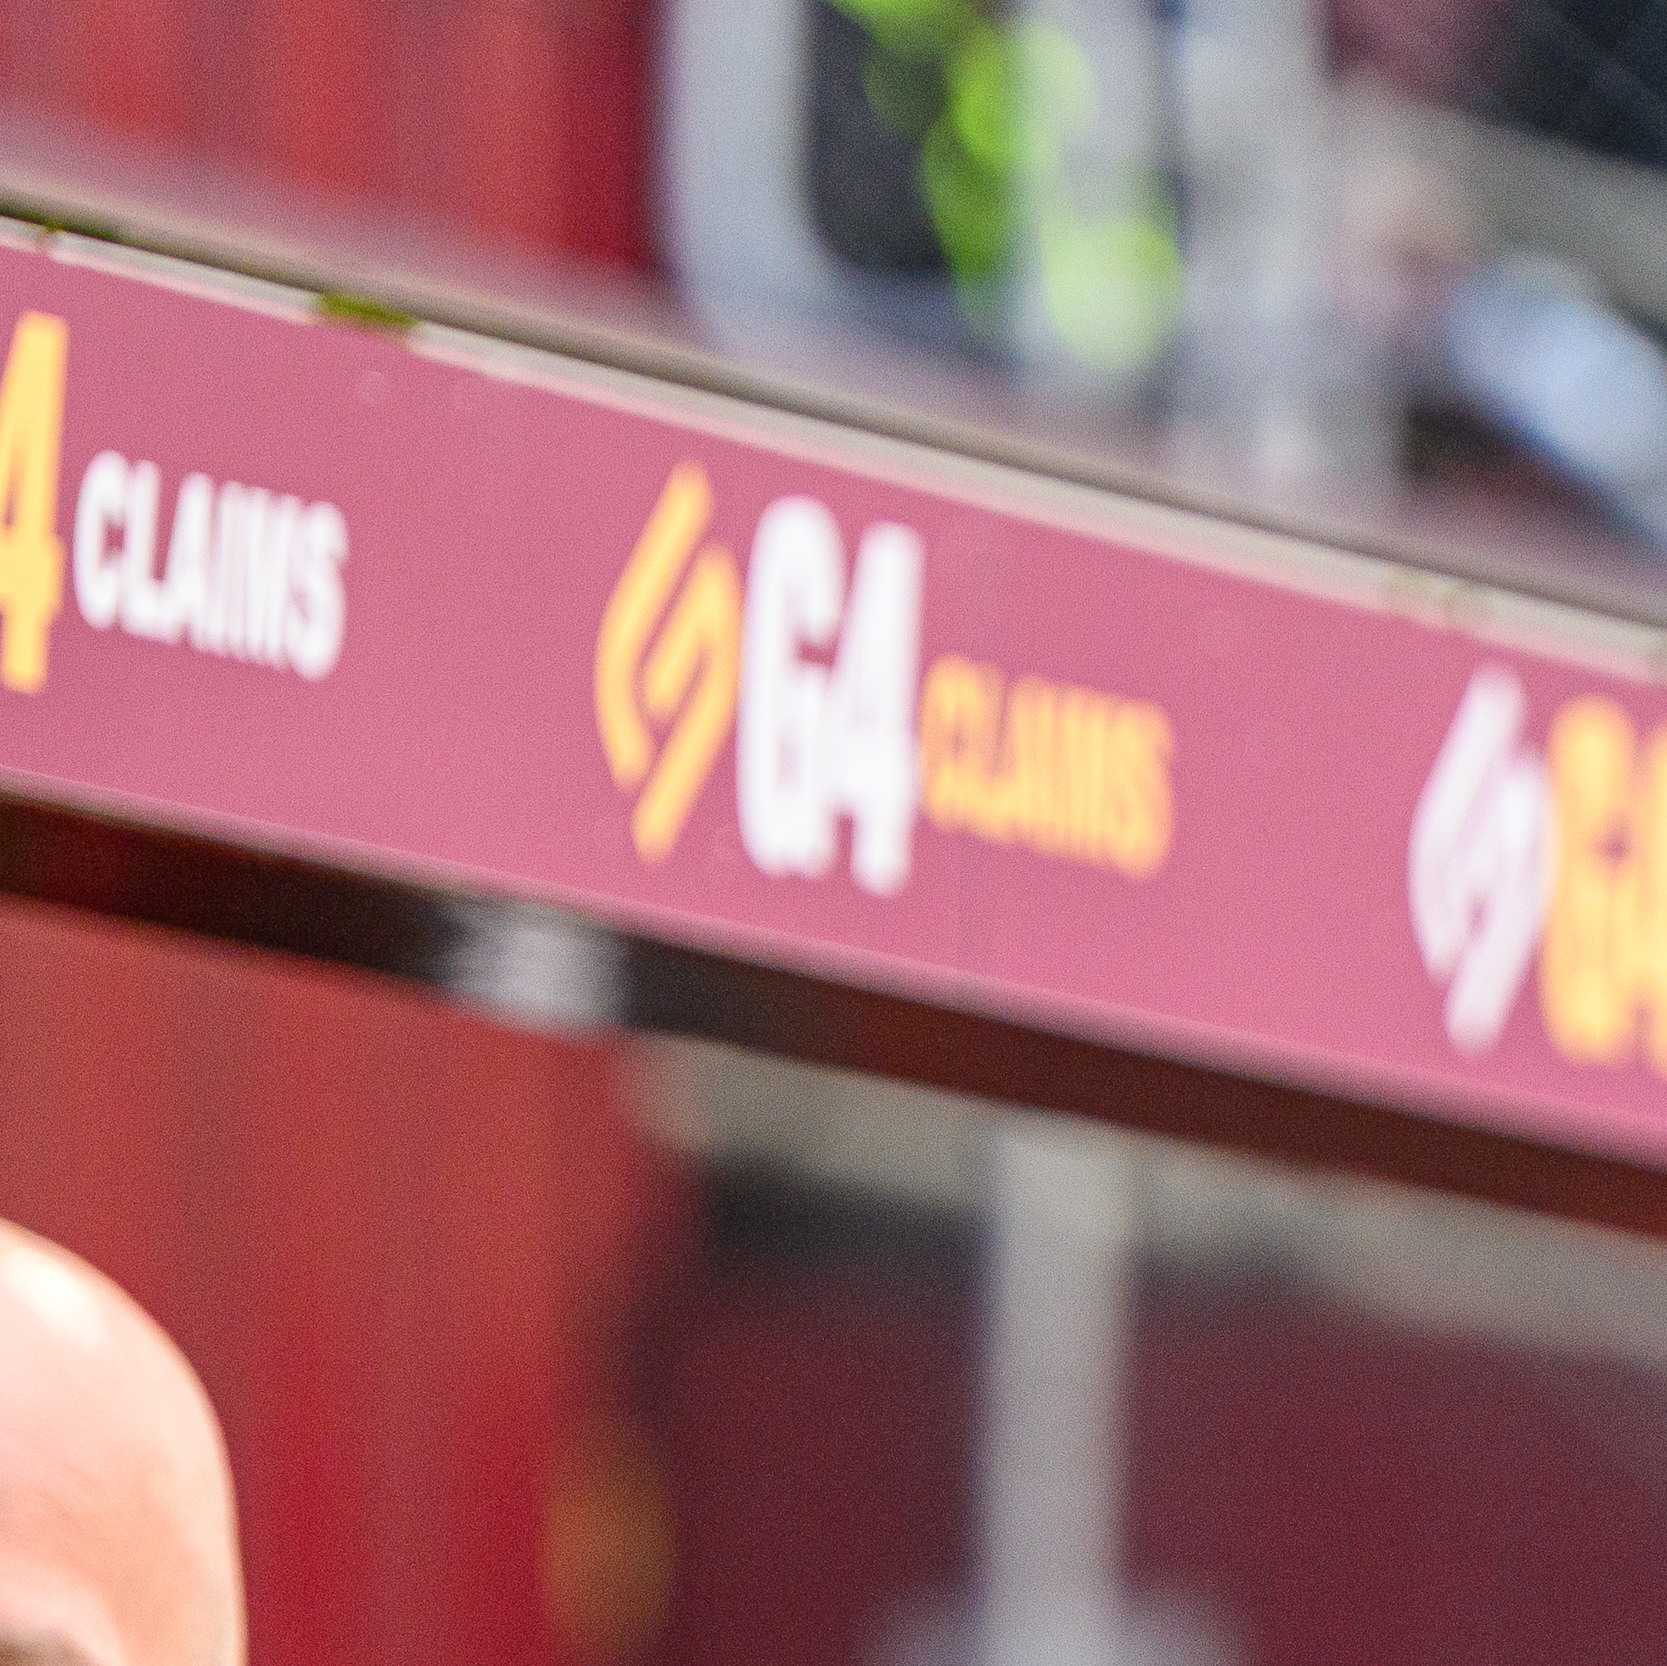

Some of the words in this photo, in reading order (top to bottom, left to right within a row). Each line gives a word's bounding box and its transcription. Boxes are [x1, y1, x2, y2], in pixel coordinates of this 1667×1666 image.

[74, 452, 348, 678] CLAIMS
[738, 497, 925, 893] G4
[920, 655, 1174, 878] CLAIMS
